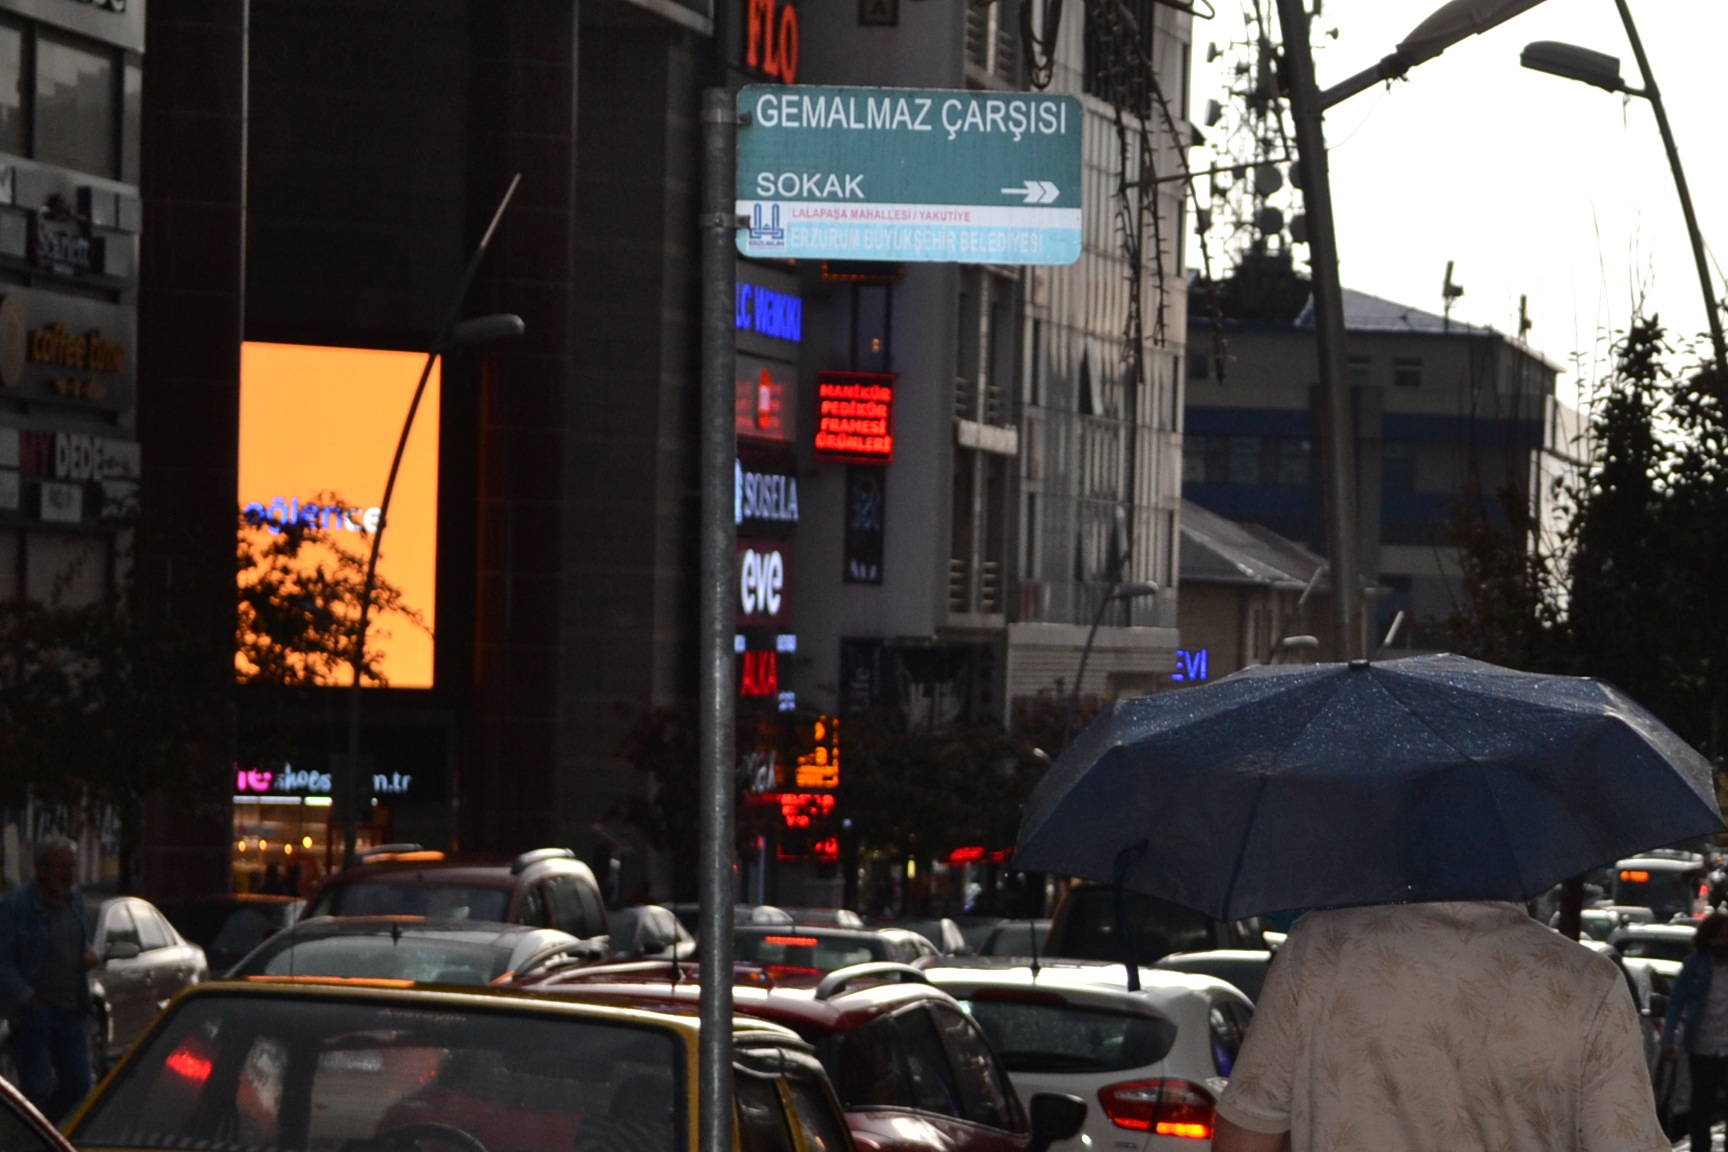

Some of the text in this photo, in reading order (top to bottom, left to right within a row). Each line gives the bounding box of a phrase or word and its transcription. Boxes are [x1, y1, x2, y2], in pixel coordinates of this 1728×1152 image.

[756, 94, 1067, 142] GEMALMAZ ÇARŞISI
[755, 172, 865, 199] SOKAK
[791, 207, 848, 221] LALAPAŞA
[851, 208, 912, 220] MAHALLESİ
[919, 210, 971, 222] YAKUTİYE
[791, 223, 1044, 256] ERZURUM BÜYÜKŞEHİR BELEDİYESİ
[741, 548, 783, 616] eve
